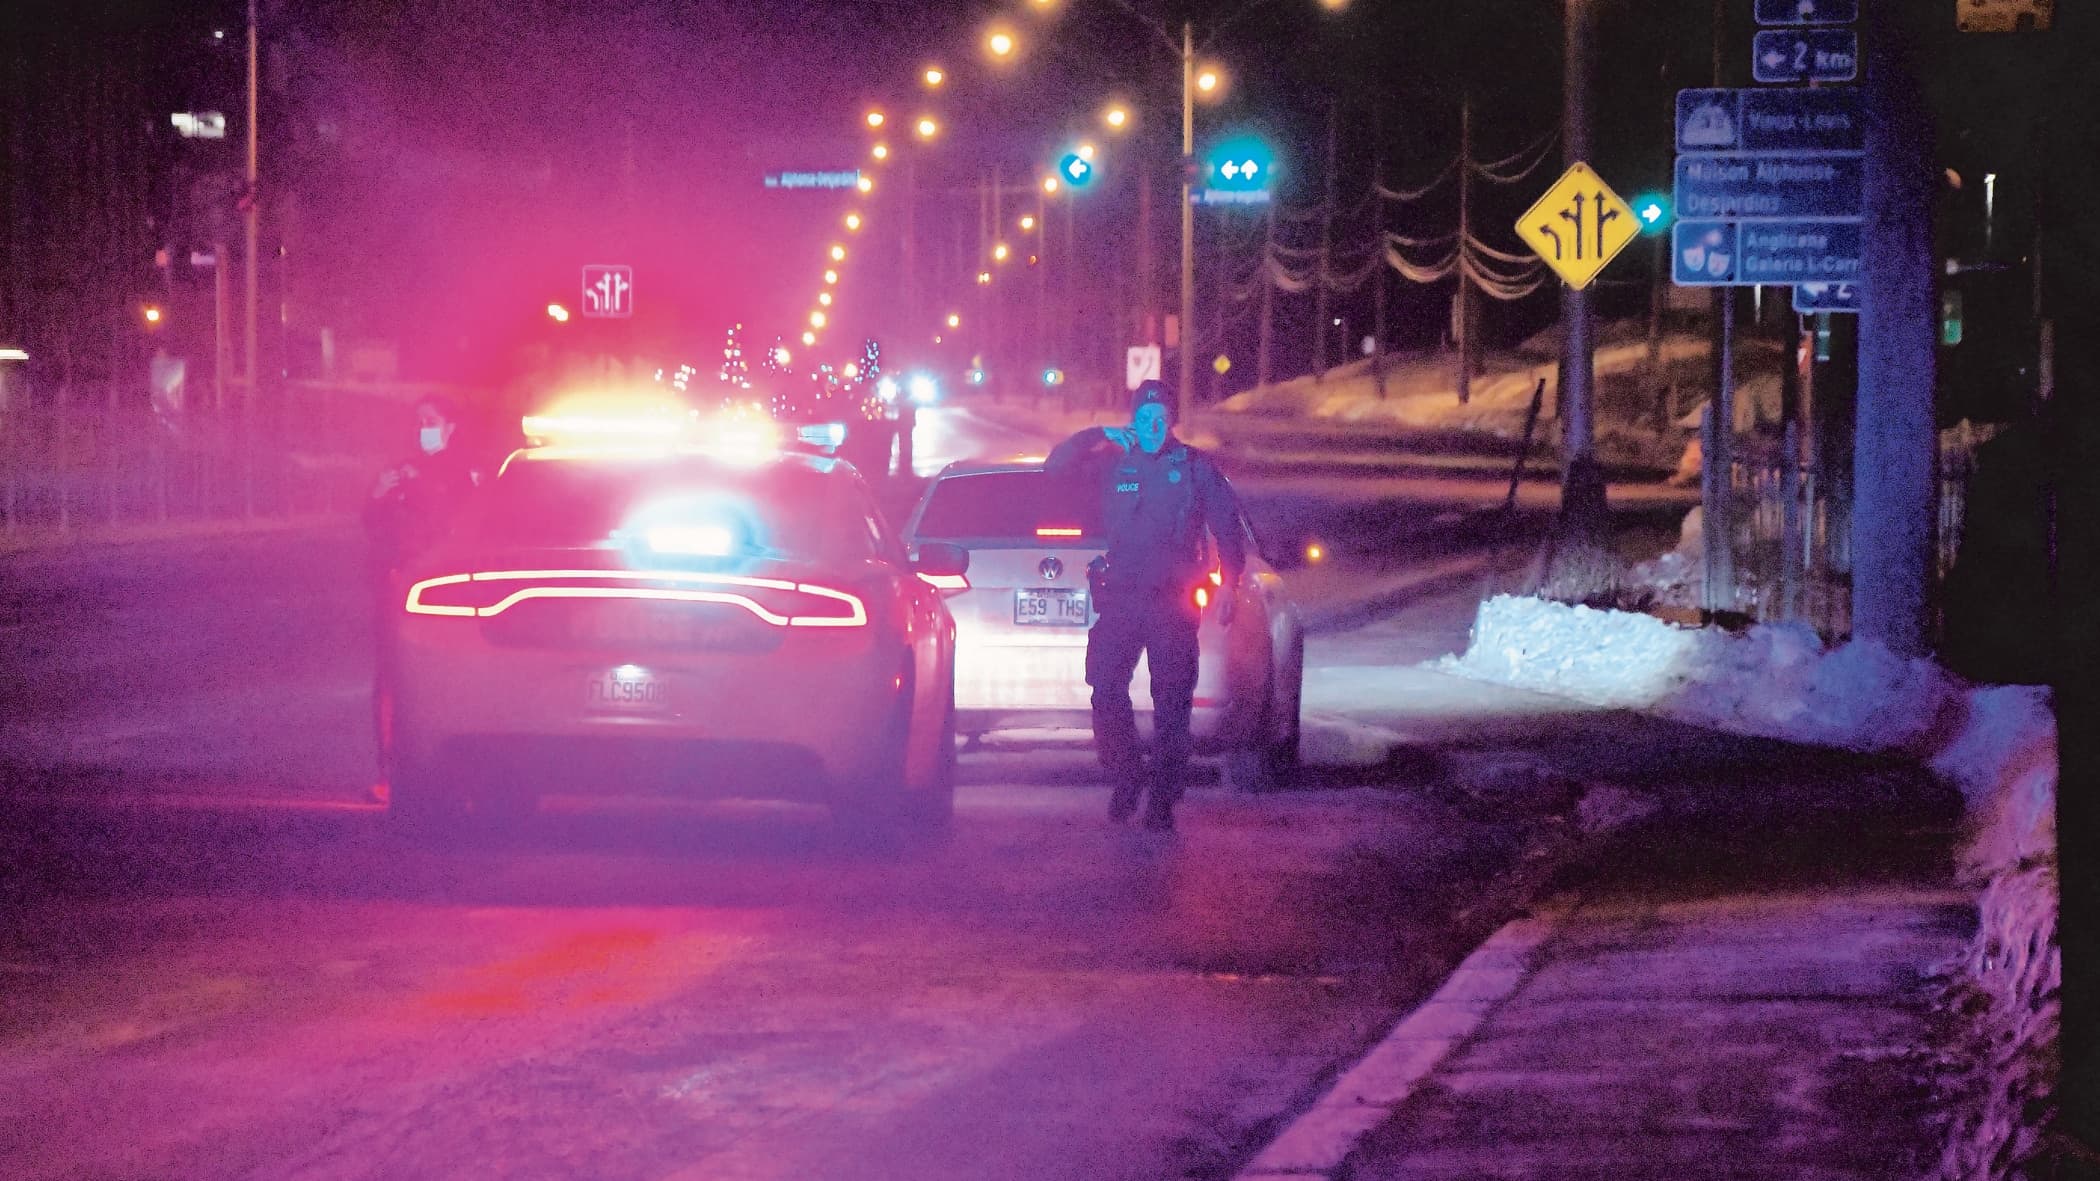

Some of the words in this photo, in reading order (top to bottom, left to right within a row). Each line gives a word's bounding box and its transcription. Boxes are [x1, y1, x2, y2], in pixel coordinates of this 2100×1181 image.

[1794, 41, 1808, 72] 2
[1815, 51, 1852, 70] km
[1117, 482, 1139, 492] POLICE
[1018, 598, 1047, 616] E59
[1057, 599, 1085, 617] THS
